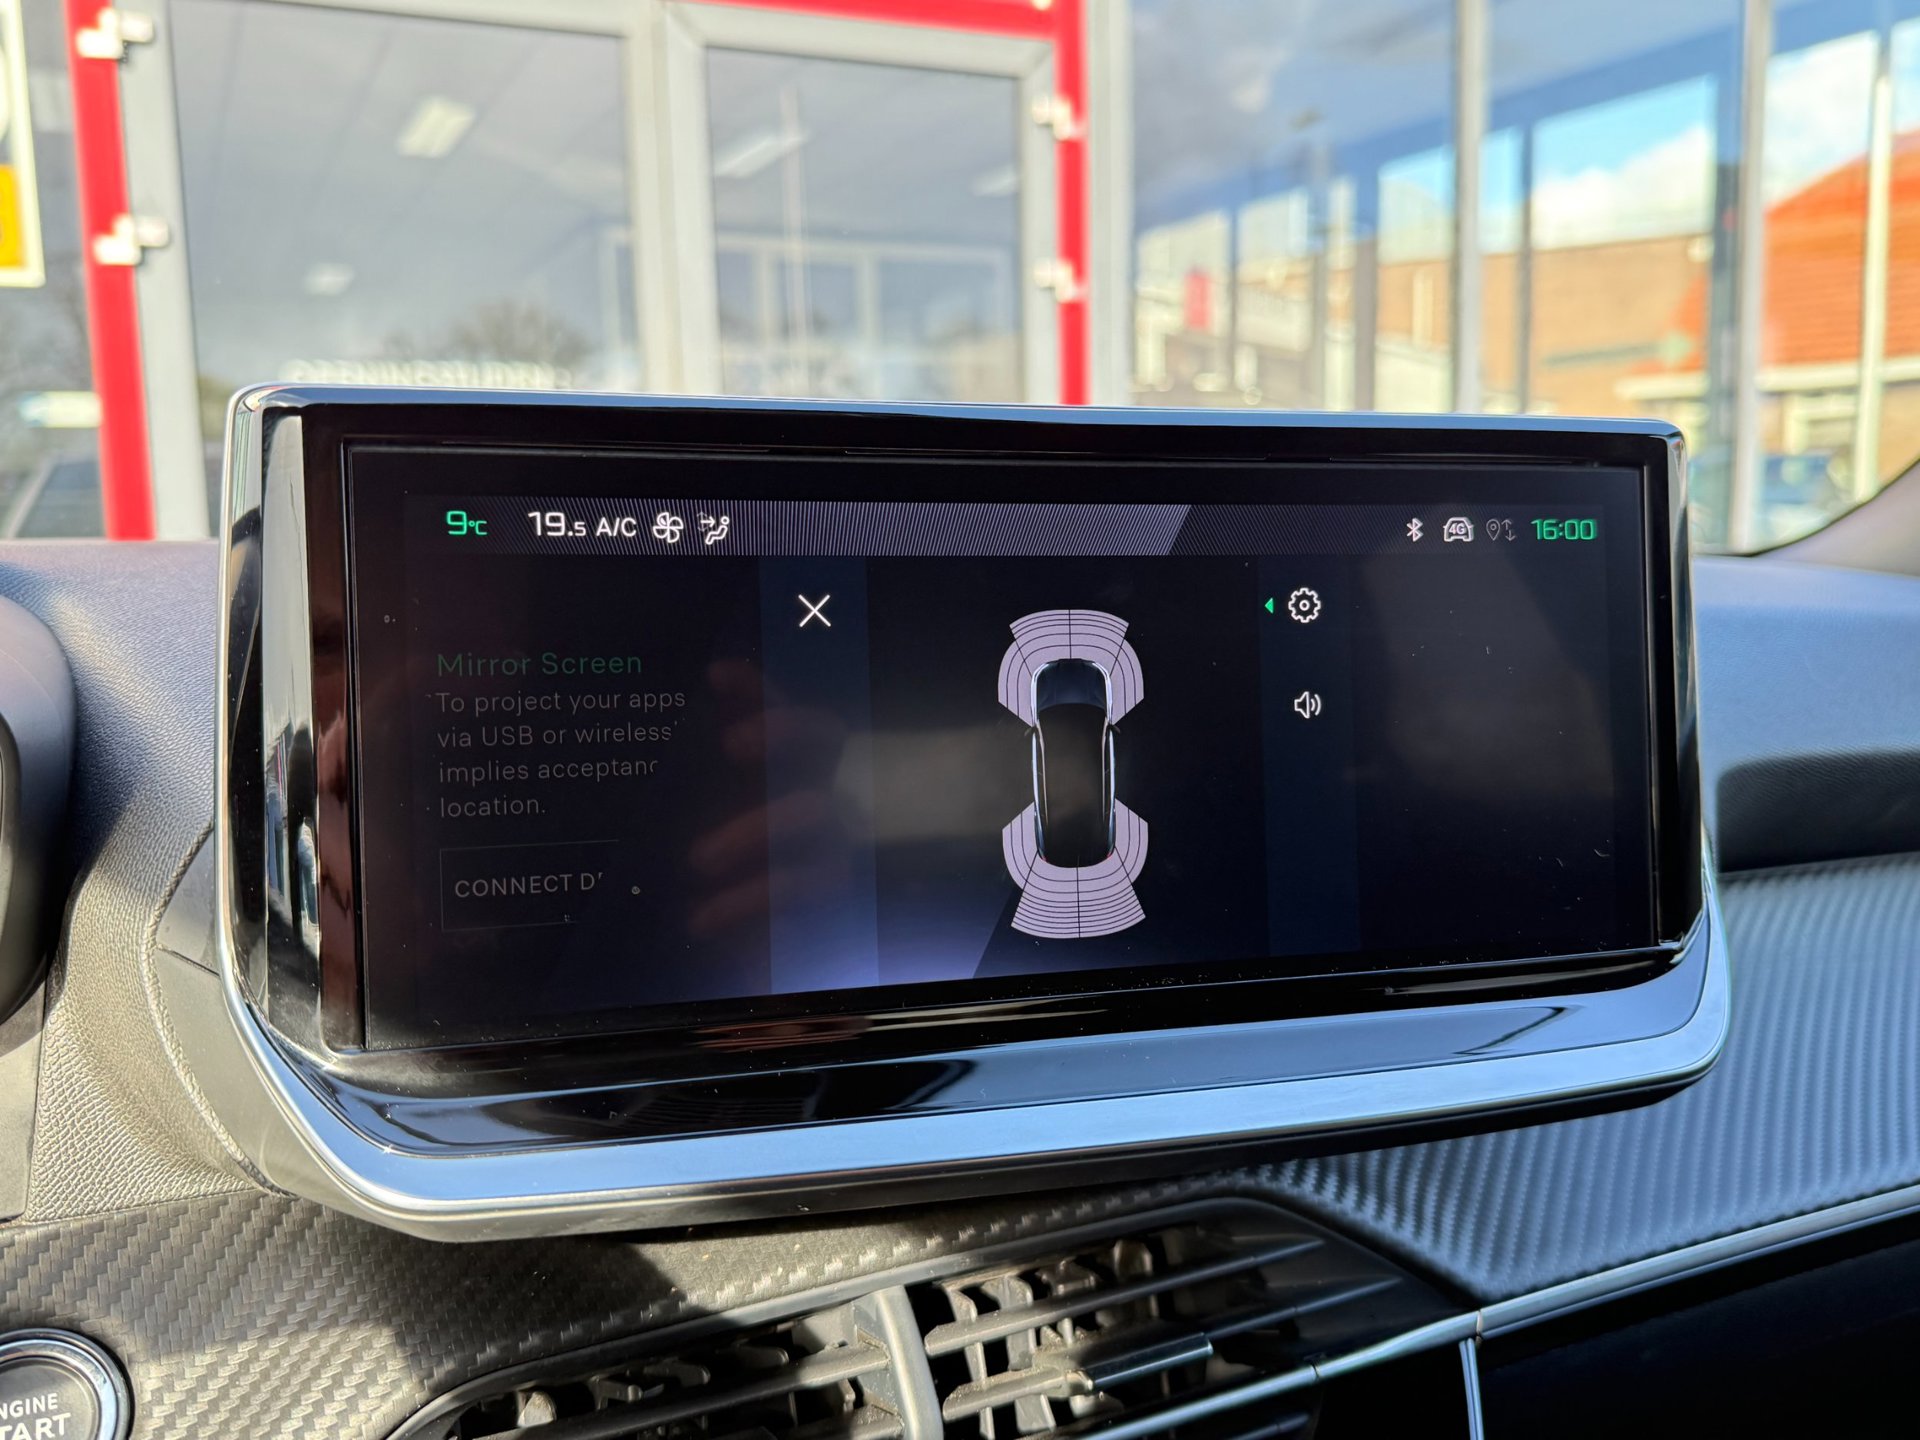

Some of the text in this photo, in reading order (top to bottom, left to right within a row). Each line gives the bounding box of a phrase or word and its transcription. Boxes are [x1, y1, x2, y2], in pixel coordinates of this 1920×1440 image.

[527, 511, 638, 537] 19.5 A/C
[1448, 522, 1467, 536] 4G
[1530, 518, 1598, 541] 16:00
[437, 651, 643, 677] Mirror Screen
[436, 690, 687, 718] To project your apps
[437, 720, 679, 748] via USB or wireless
[438, 760, 530, 787] implies
[440, 793, 547, 818] location.
[454, 873, 573, 898] CONNECT
[0, 1392, 58, 1420] NGINE
